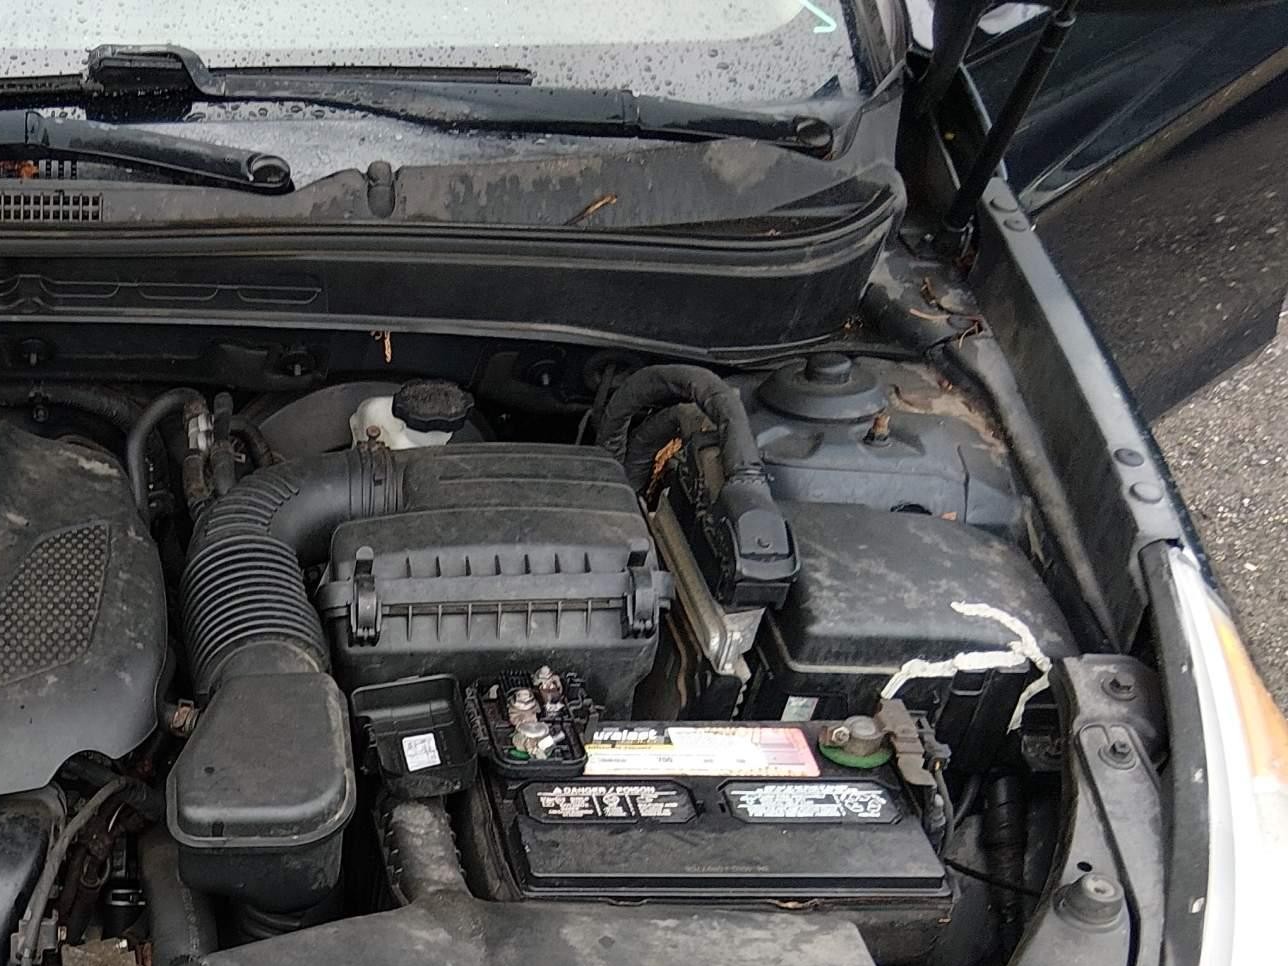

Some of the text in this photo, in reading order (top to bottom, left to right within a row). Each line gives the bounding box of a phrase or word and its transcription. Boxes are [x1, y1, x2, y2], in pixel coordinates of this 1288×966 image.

[593, 729, 658, 741] uralast
[564, 786, 607, 796] DANGER
[616, 786, 656, 796] POISON
